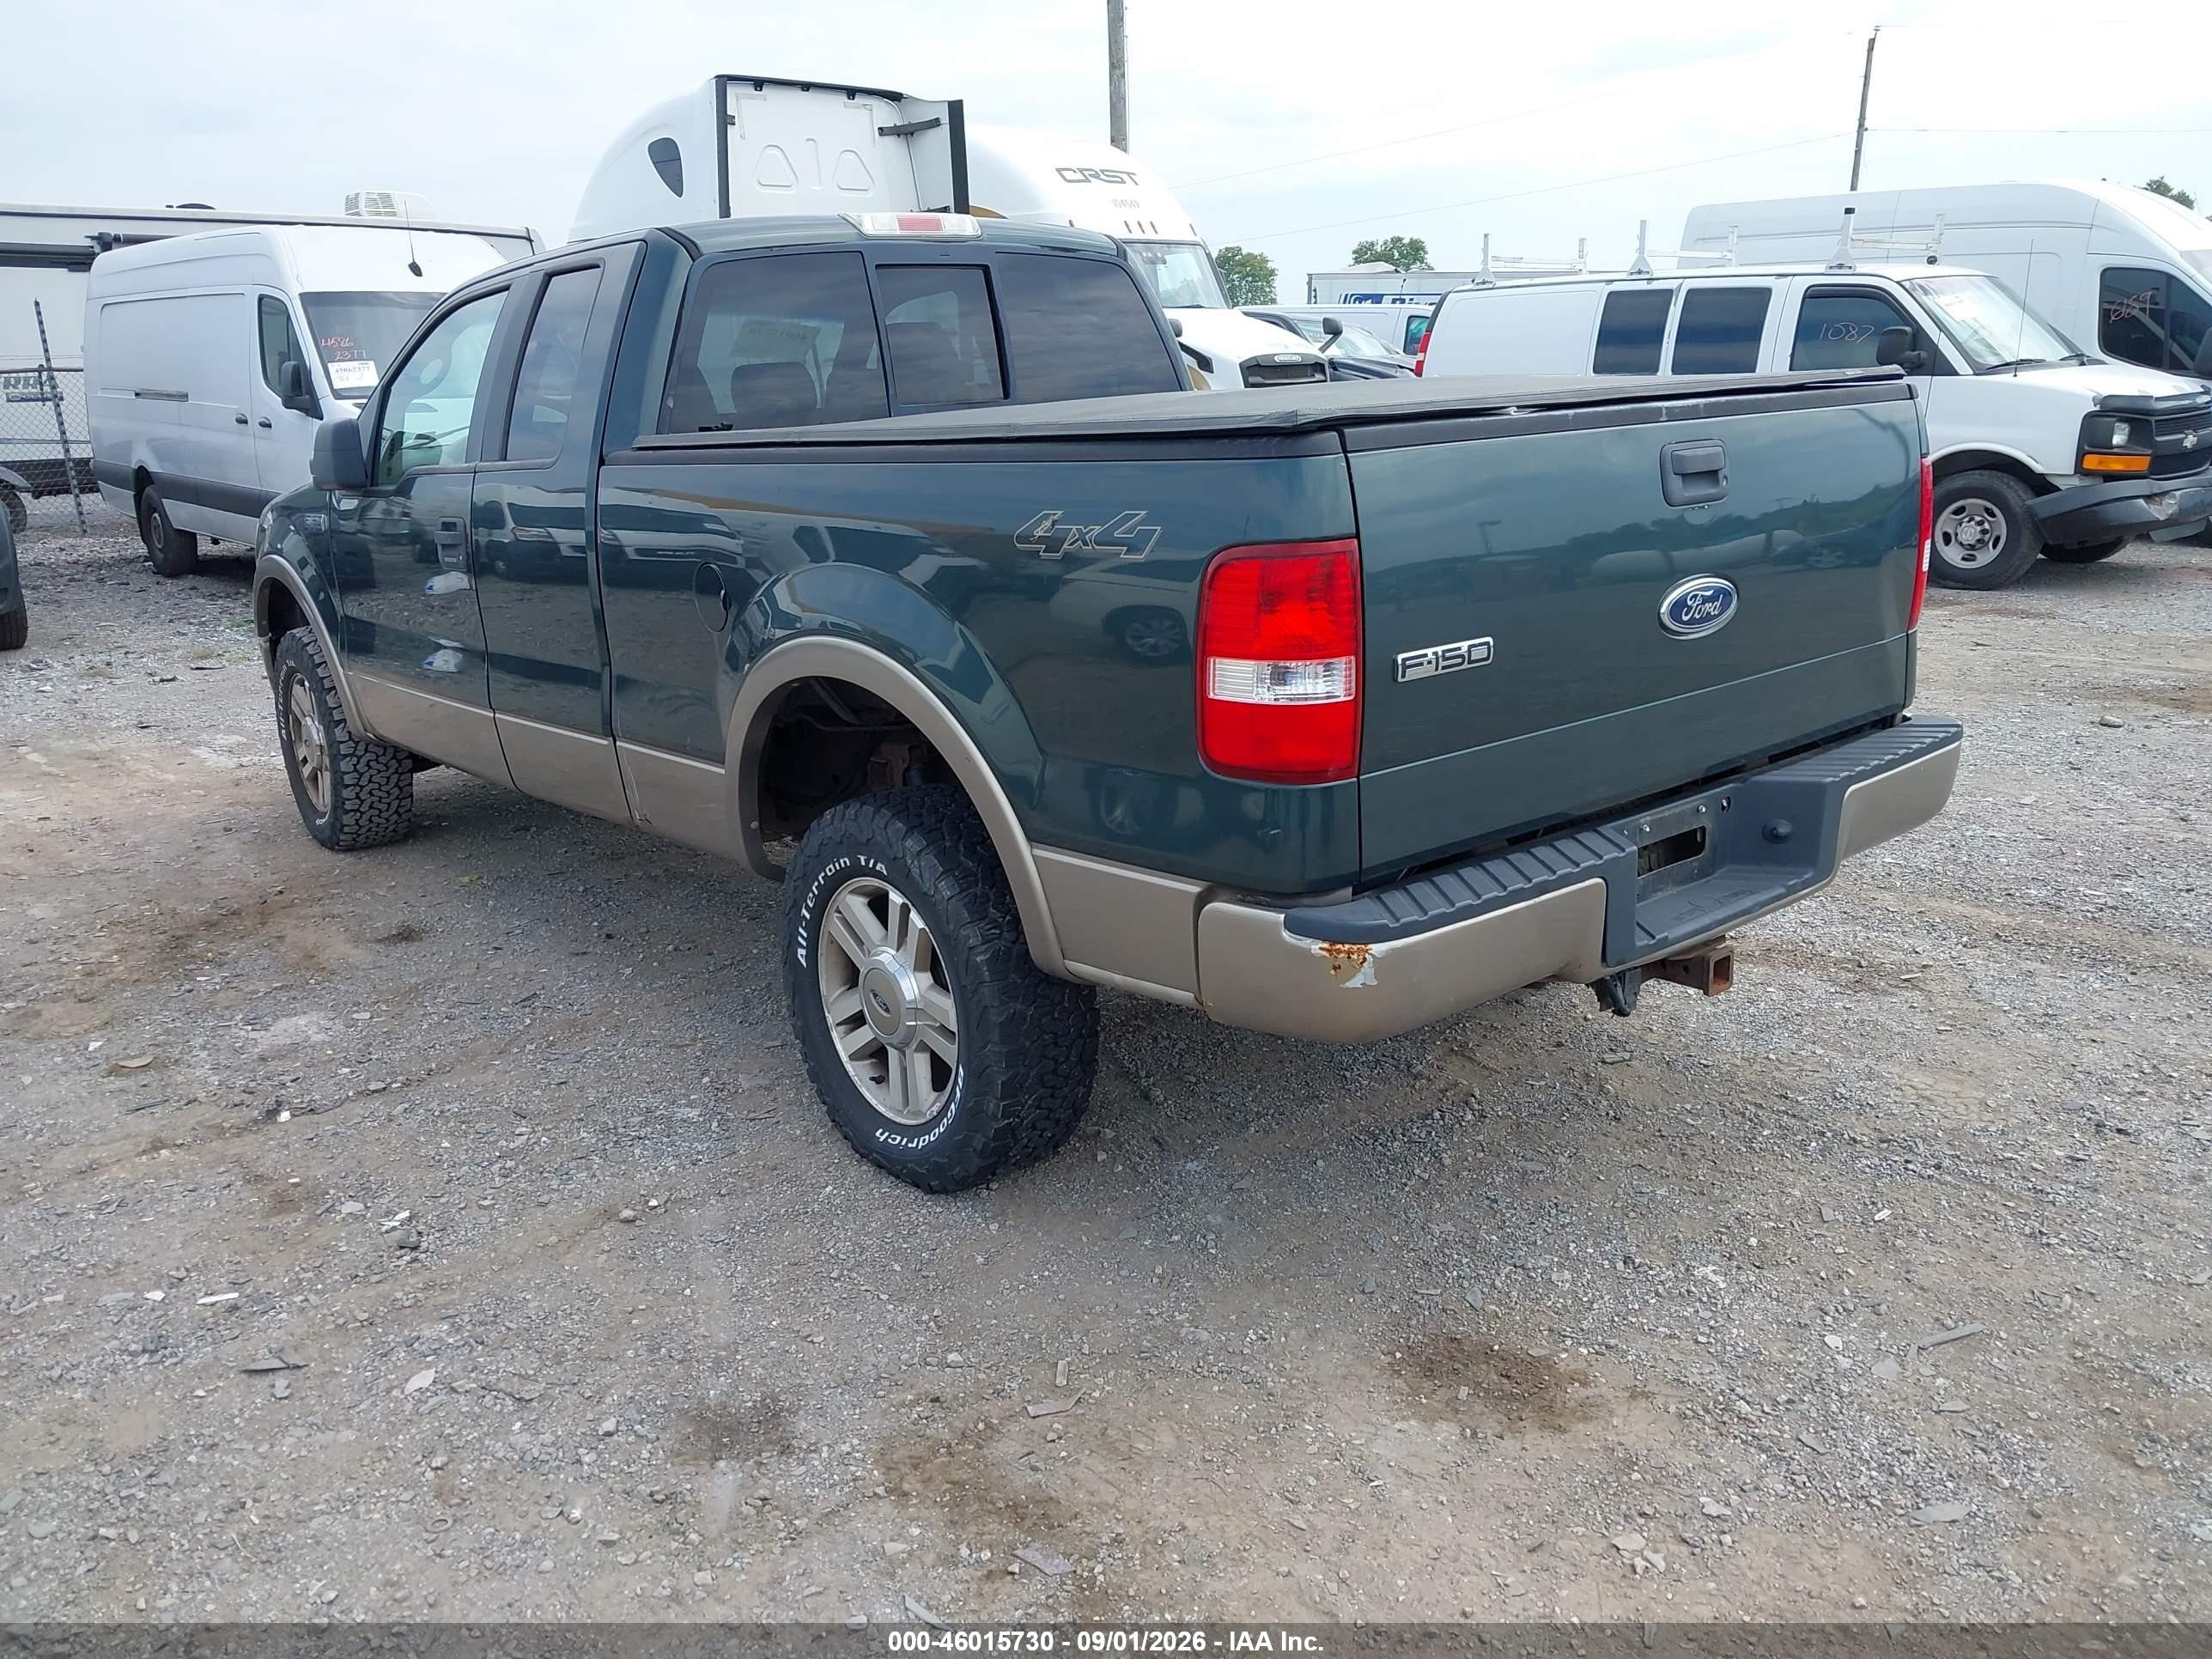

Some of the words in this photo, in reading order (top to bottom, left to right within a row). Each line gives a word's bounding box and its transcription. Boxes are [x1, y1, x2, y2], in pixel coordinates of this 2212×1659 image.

[1055, 167, 1139, 185] CRST
[321, 337, 354, 348] 4586
[1820, 322, 1875, 343] 1087
[335, 349, 367, 361] 2377
[1013, 510, 1162, 562] 4x4
[1681, 589, 1723, 622] Ford
[1401, 641, 1492, 679] F-150
[797, 857, 851, 969] All-Terrain
[875, 1063, 964, 1150] BFGoodrich
